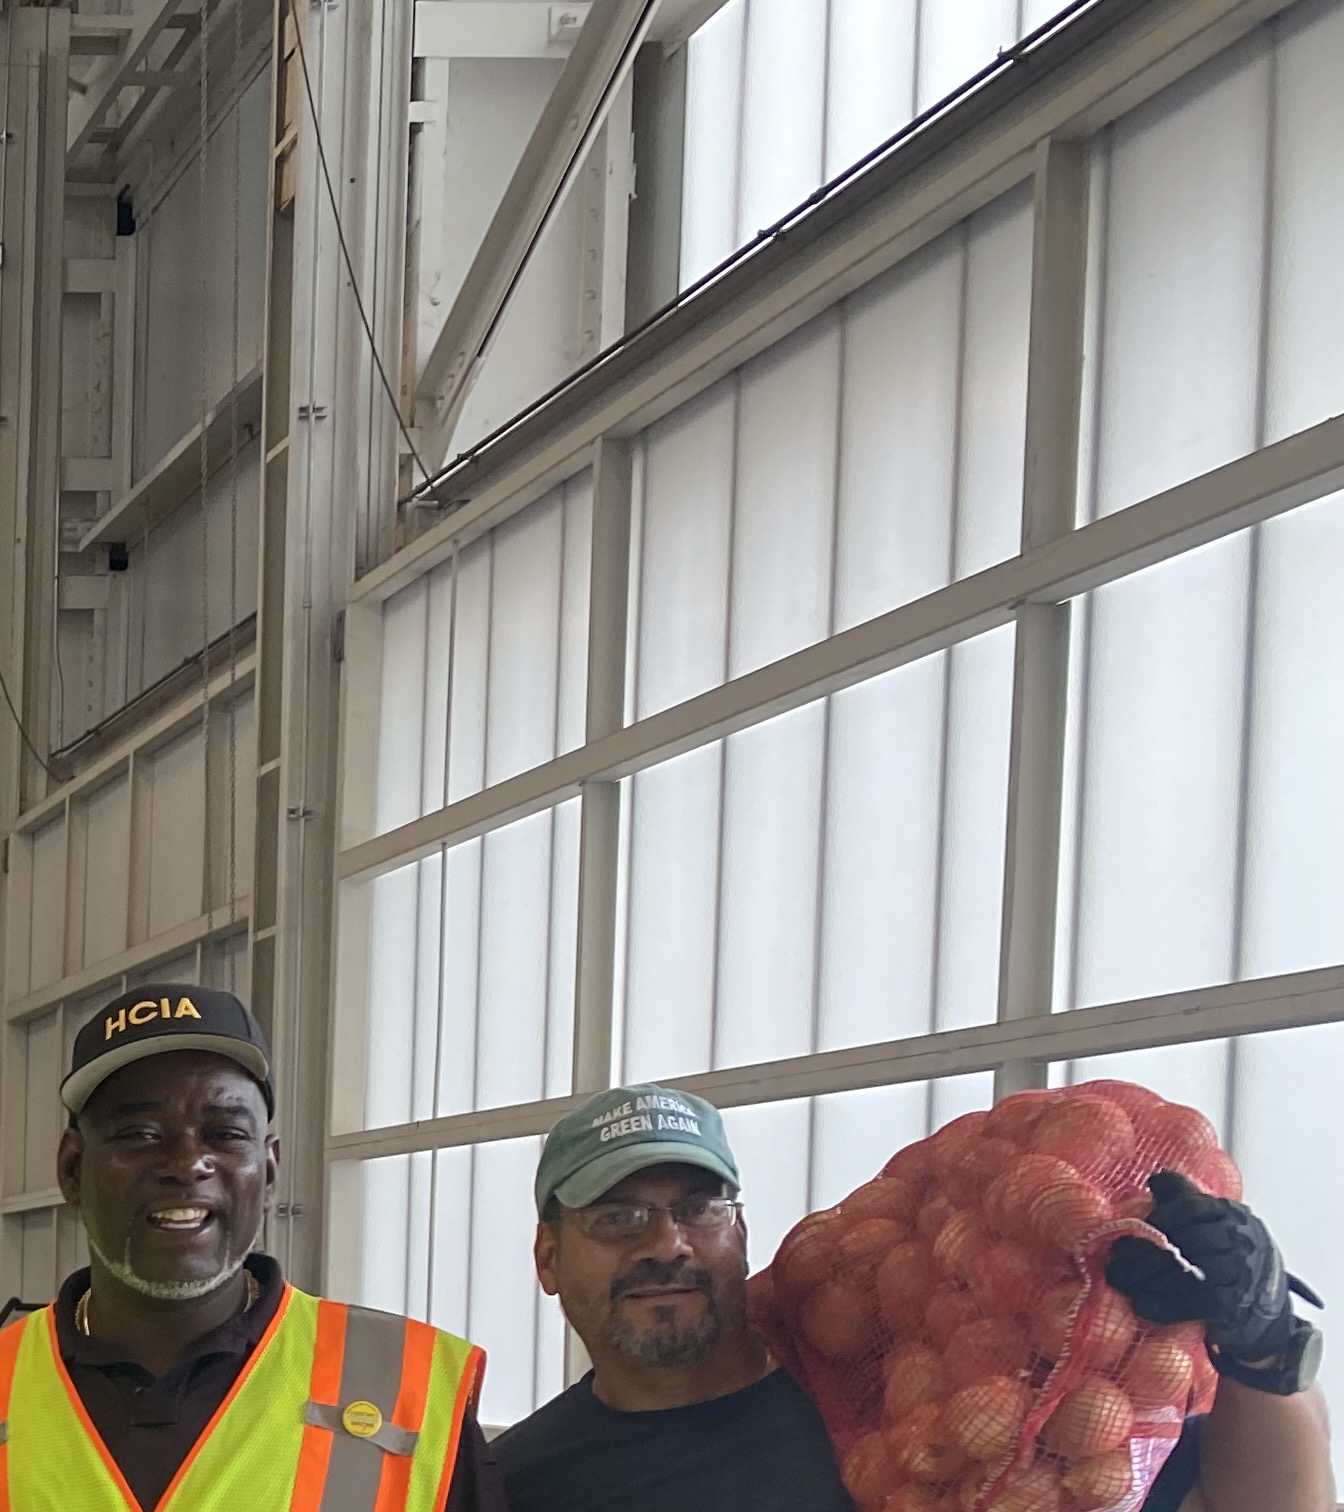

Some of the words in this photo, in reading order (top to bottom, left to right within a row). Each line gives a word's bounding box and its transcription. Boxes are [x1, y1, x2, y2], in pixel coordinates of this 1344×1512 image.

[105, 997, 202, 1040] HCIA
[592, 1101, 633, 1128] MAKE
[600, 1114, 653, 1142] GREEN
[658, 1114, 702, 1136] AGAIN
